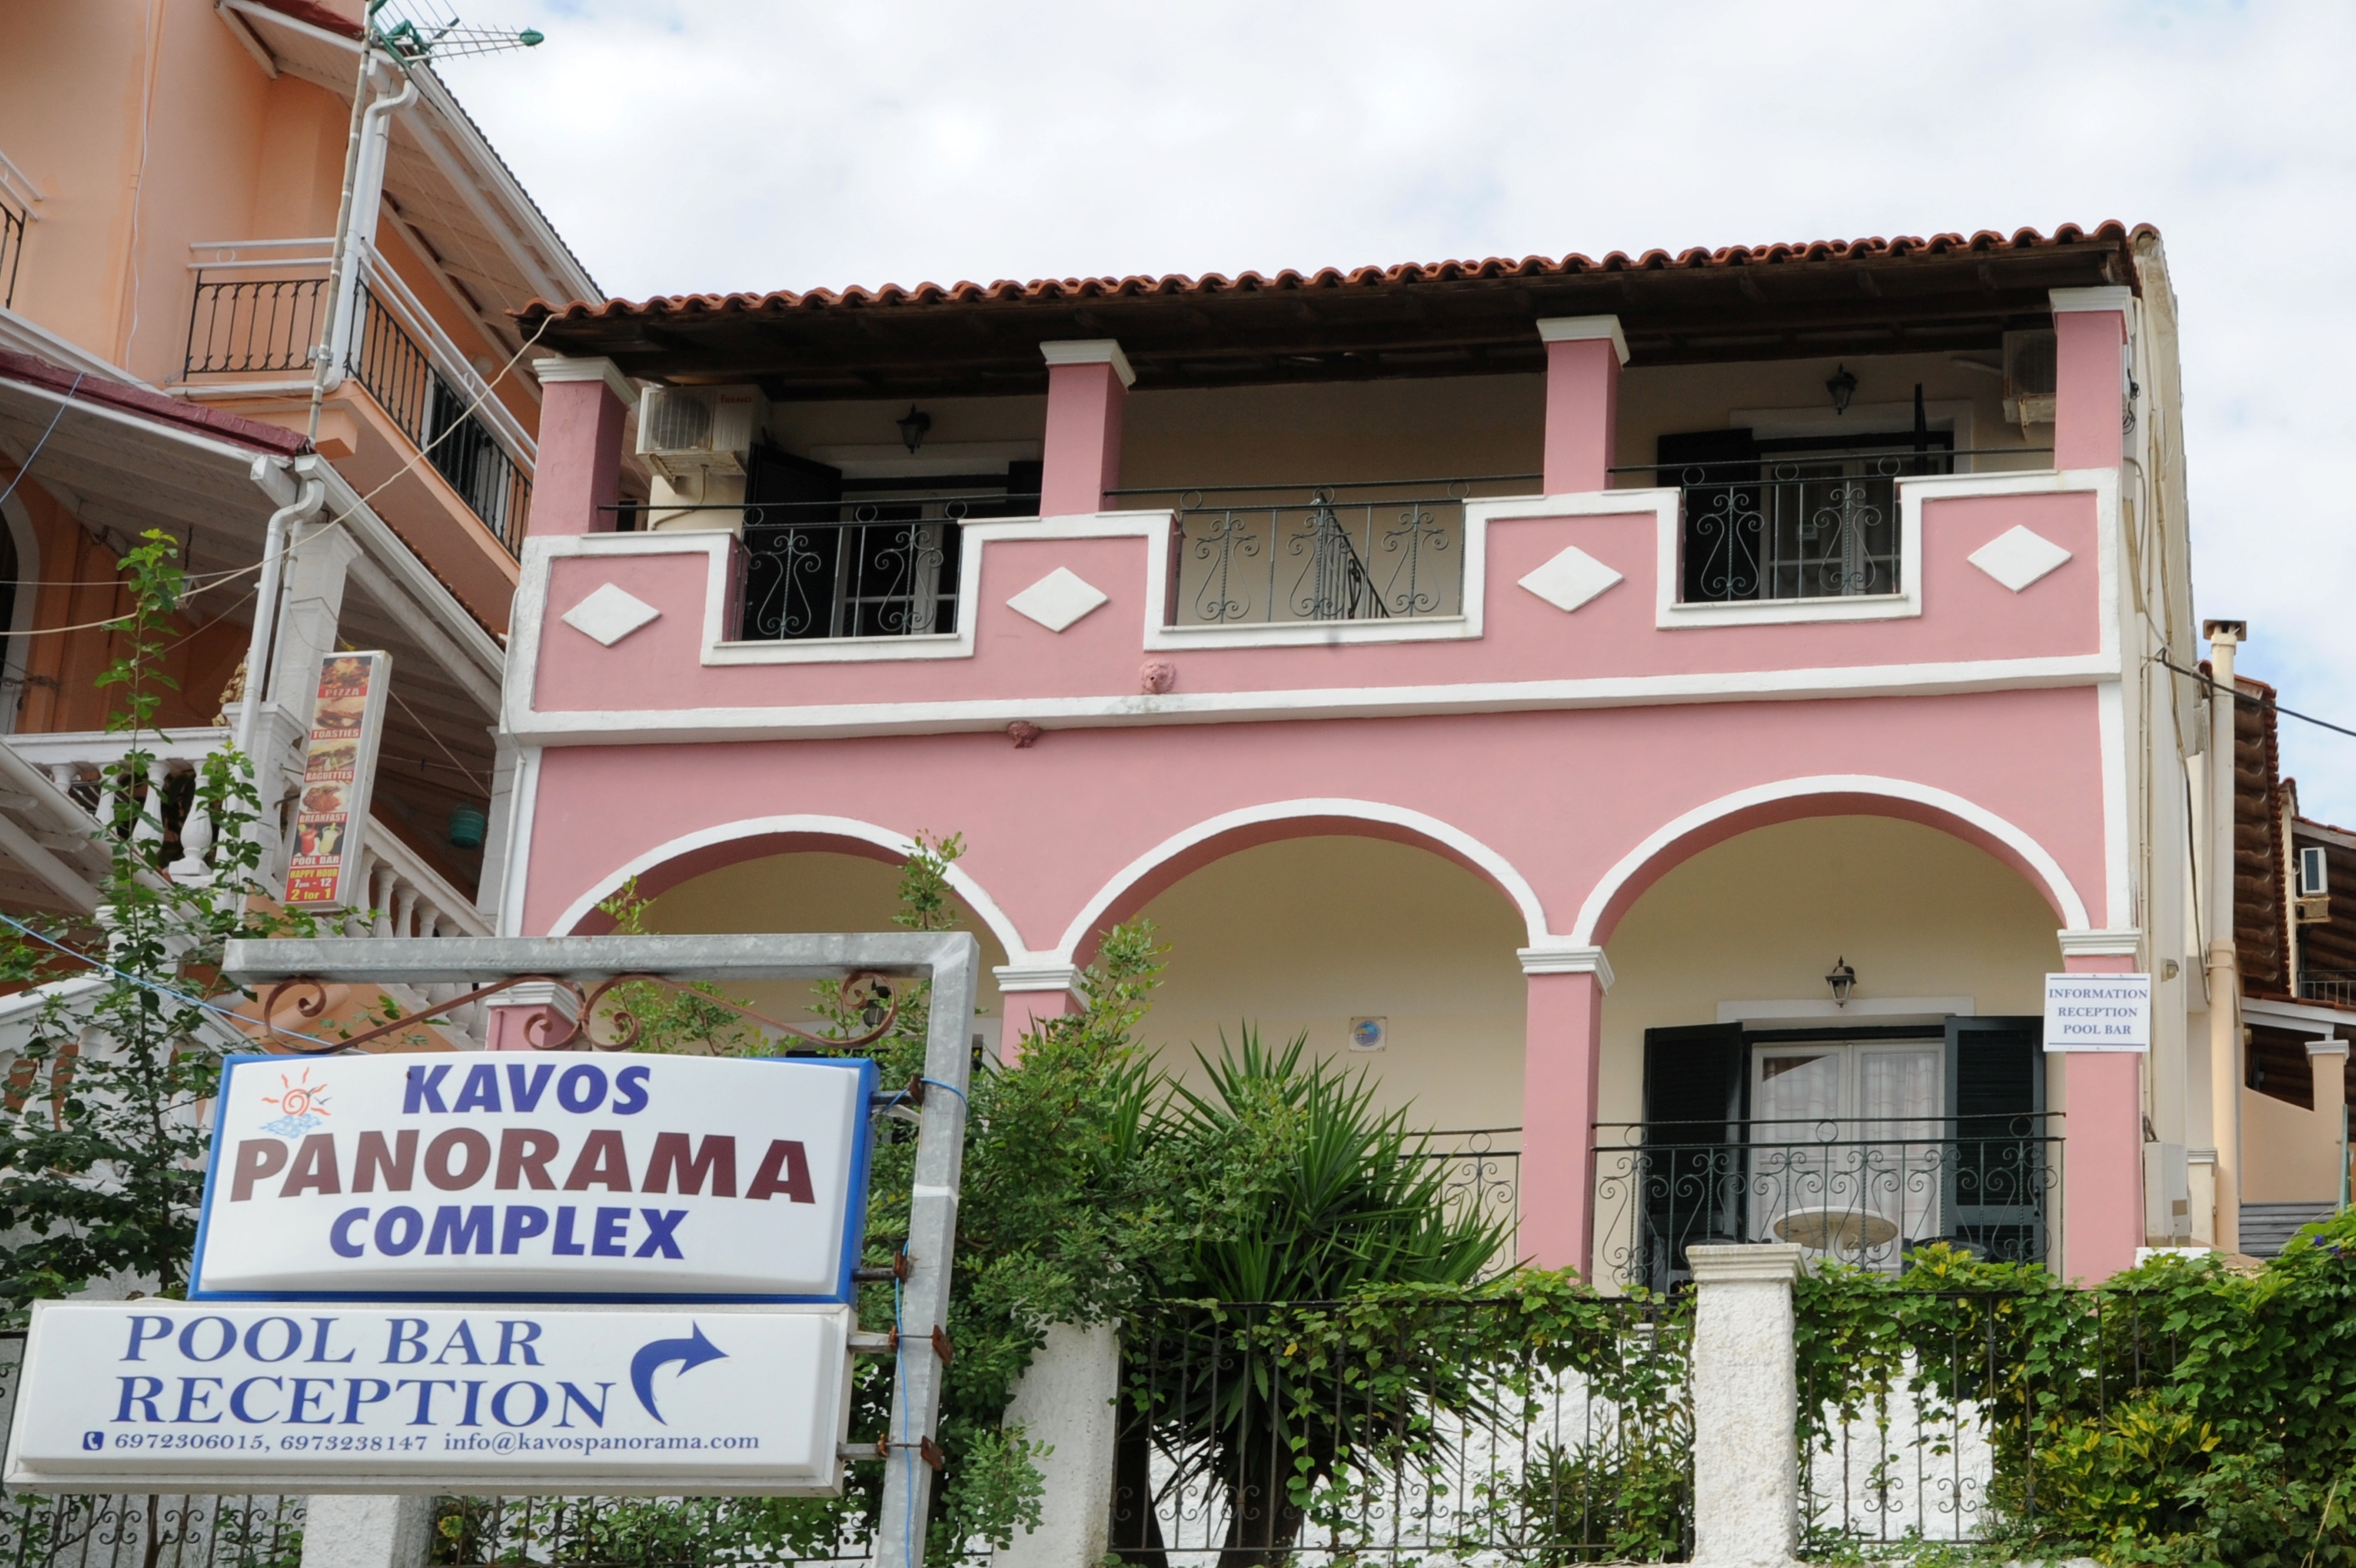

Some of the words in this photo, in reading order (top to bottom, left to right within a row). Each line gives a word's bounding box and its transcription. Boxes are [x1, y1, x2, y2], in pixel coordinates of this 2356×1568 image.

[324, 687, 360, 697] PIZZA
[313, 728, 359, 739] TOASTIES
[305, 770, 352, 781] BAGUETTES
[298, 812, 347, 823] BREAKFAST
[292, 856, 316, 866] POOL
[319, 855, 339, 865] BAR
[289, 869, 315, 879] HAPPY
[316, 868, 338, 877] HOUR
[320, 878, 332, 887] 12
[290, 888, 300, 900] 2
[303, 890, 320, 900] for
[324, 887, 331, 900] 1
[2048, 989, 2148, 999] INFORMATION
[2058, 1007, 2138, 1018] RECEPTION
[2063, 1024, 2102, 1035] POOL
[2104, 1024, 2132, 1035] BAR
[402, 1063, 651, 1116] KAVOS
[229, 1127, 816, 1205] PANORAMA
[329, 1205, 689, 1260] COMPLEX
[119, 1315, 356, 1363] POOL
[380, 1318, 545, 1366] BAR
[110, 1376, 617, 1428] RECEPTION
[114, 1434, 271, 1452] 6972306015,
[280, 1436, 428, 1452] 6973238147
[444, 1432, 760, 1456] info@kavospanorama.com
